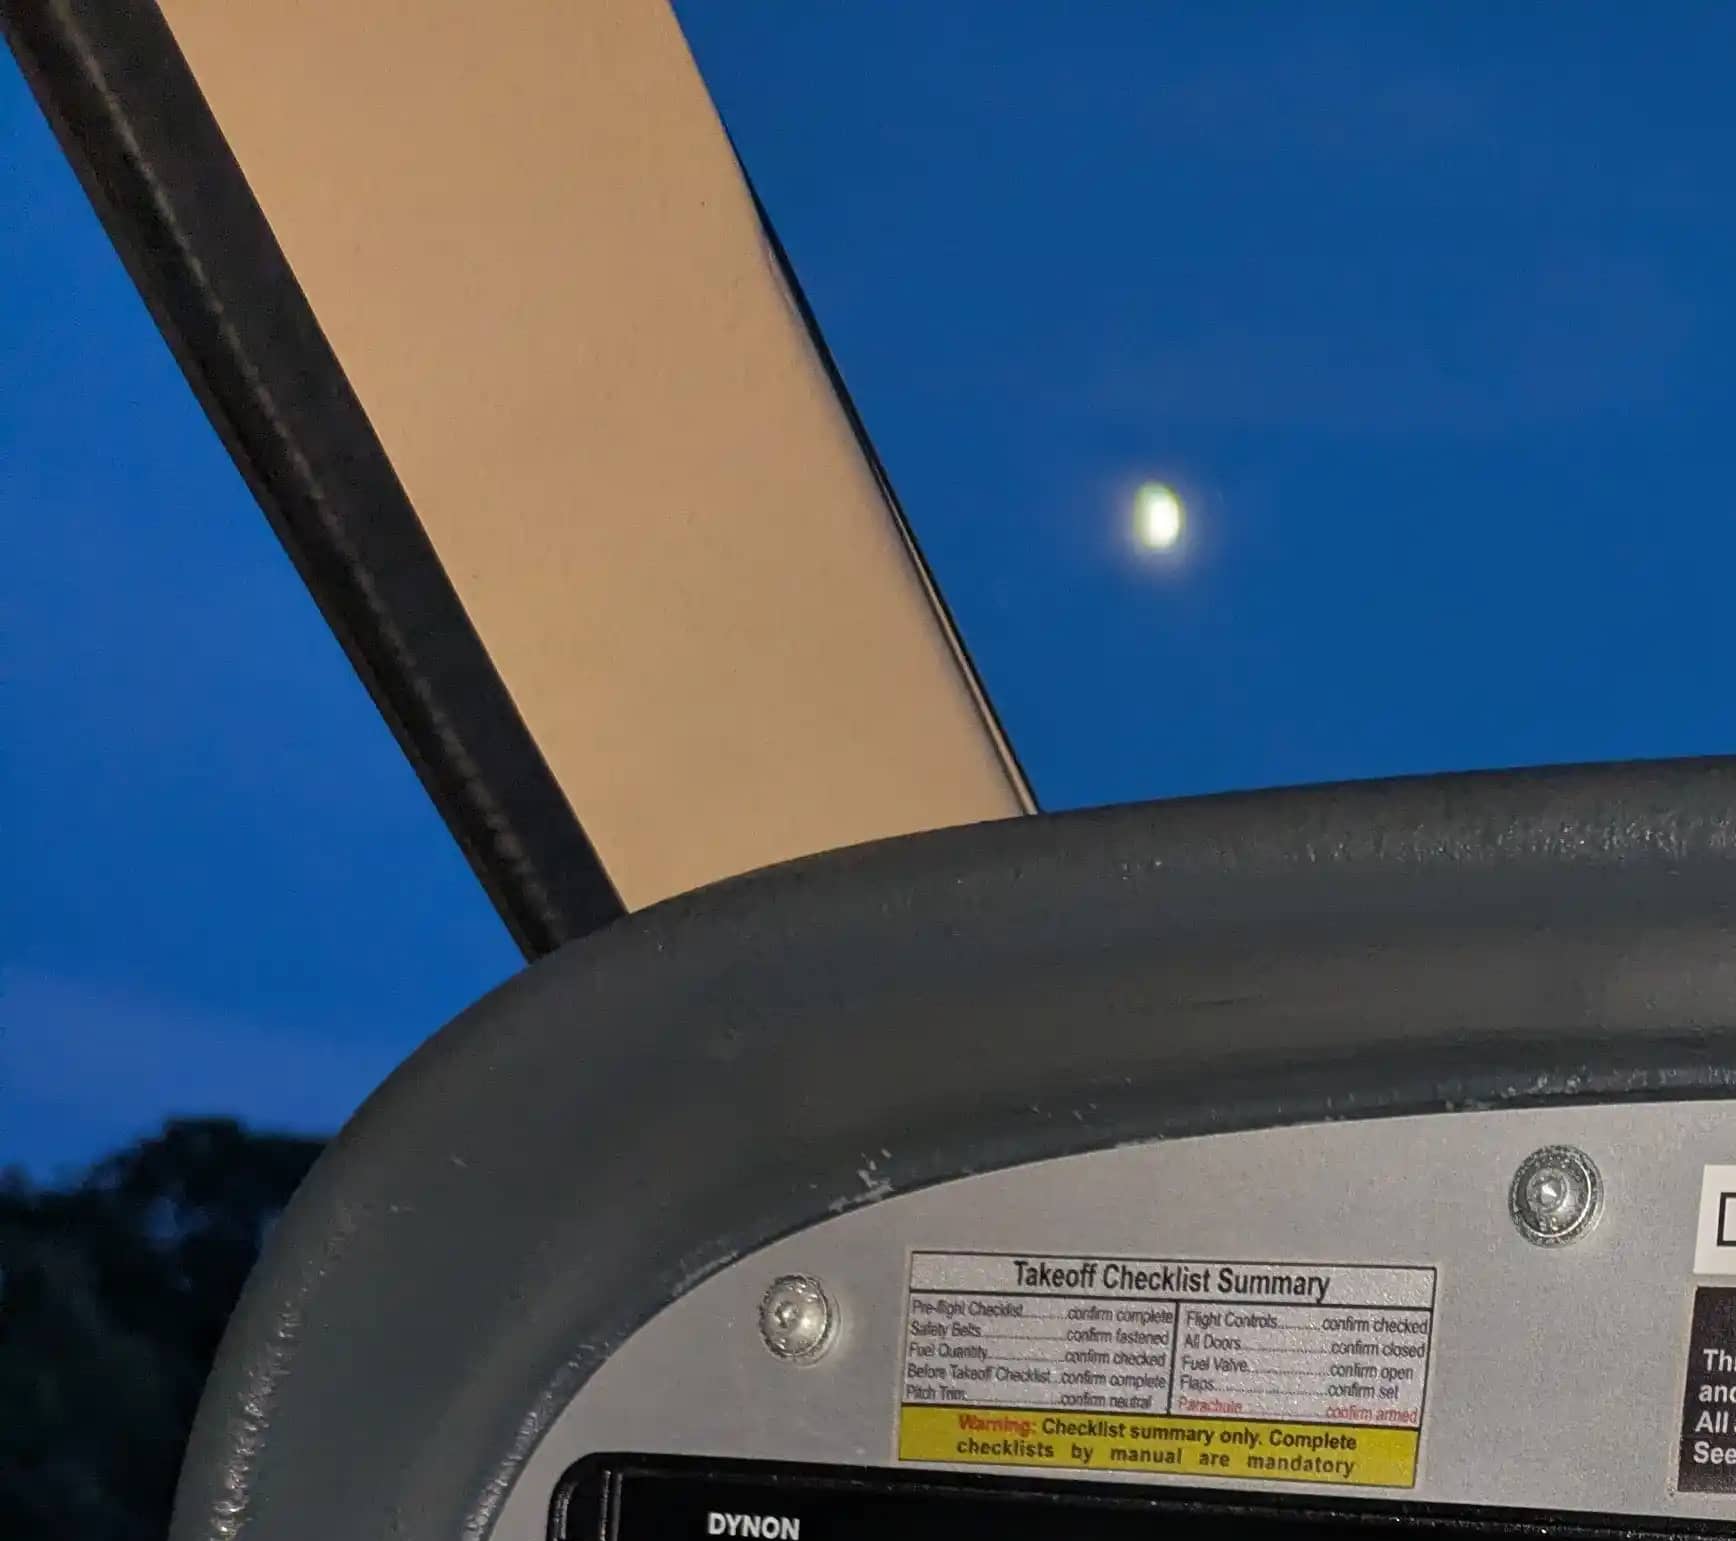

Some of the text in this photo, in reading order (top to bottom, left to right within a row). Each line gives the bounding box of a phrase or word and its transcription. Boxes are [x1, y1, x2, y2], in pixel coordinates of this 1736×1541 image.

[1014, 1261, 1330, 1303] Takeoff Checklist Summary
[1186, 1310, 1220, 1328] Flight
[1374, 1317, 1428, 1334] checked
[959, 1414, 1356, 1451] Warning: Checklist summary only. Complete
[1695, 1411, 1728, 1433] All
[957, 1438, 1354, 1477] checklists by manual are mandatory
[707, 1512, 800, 1541] DYNON
